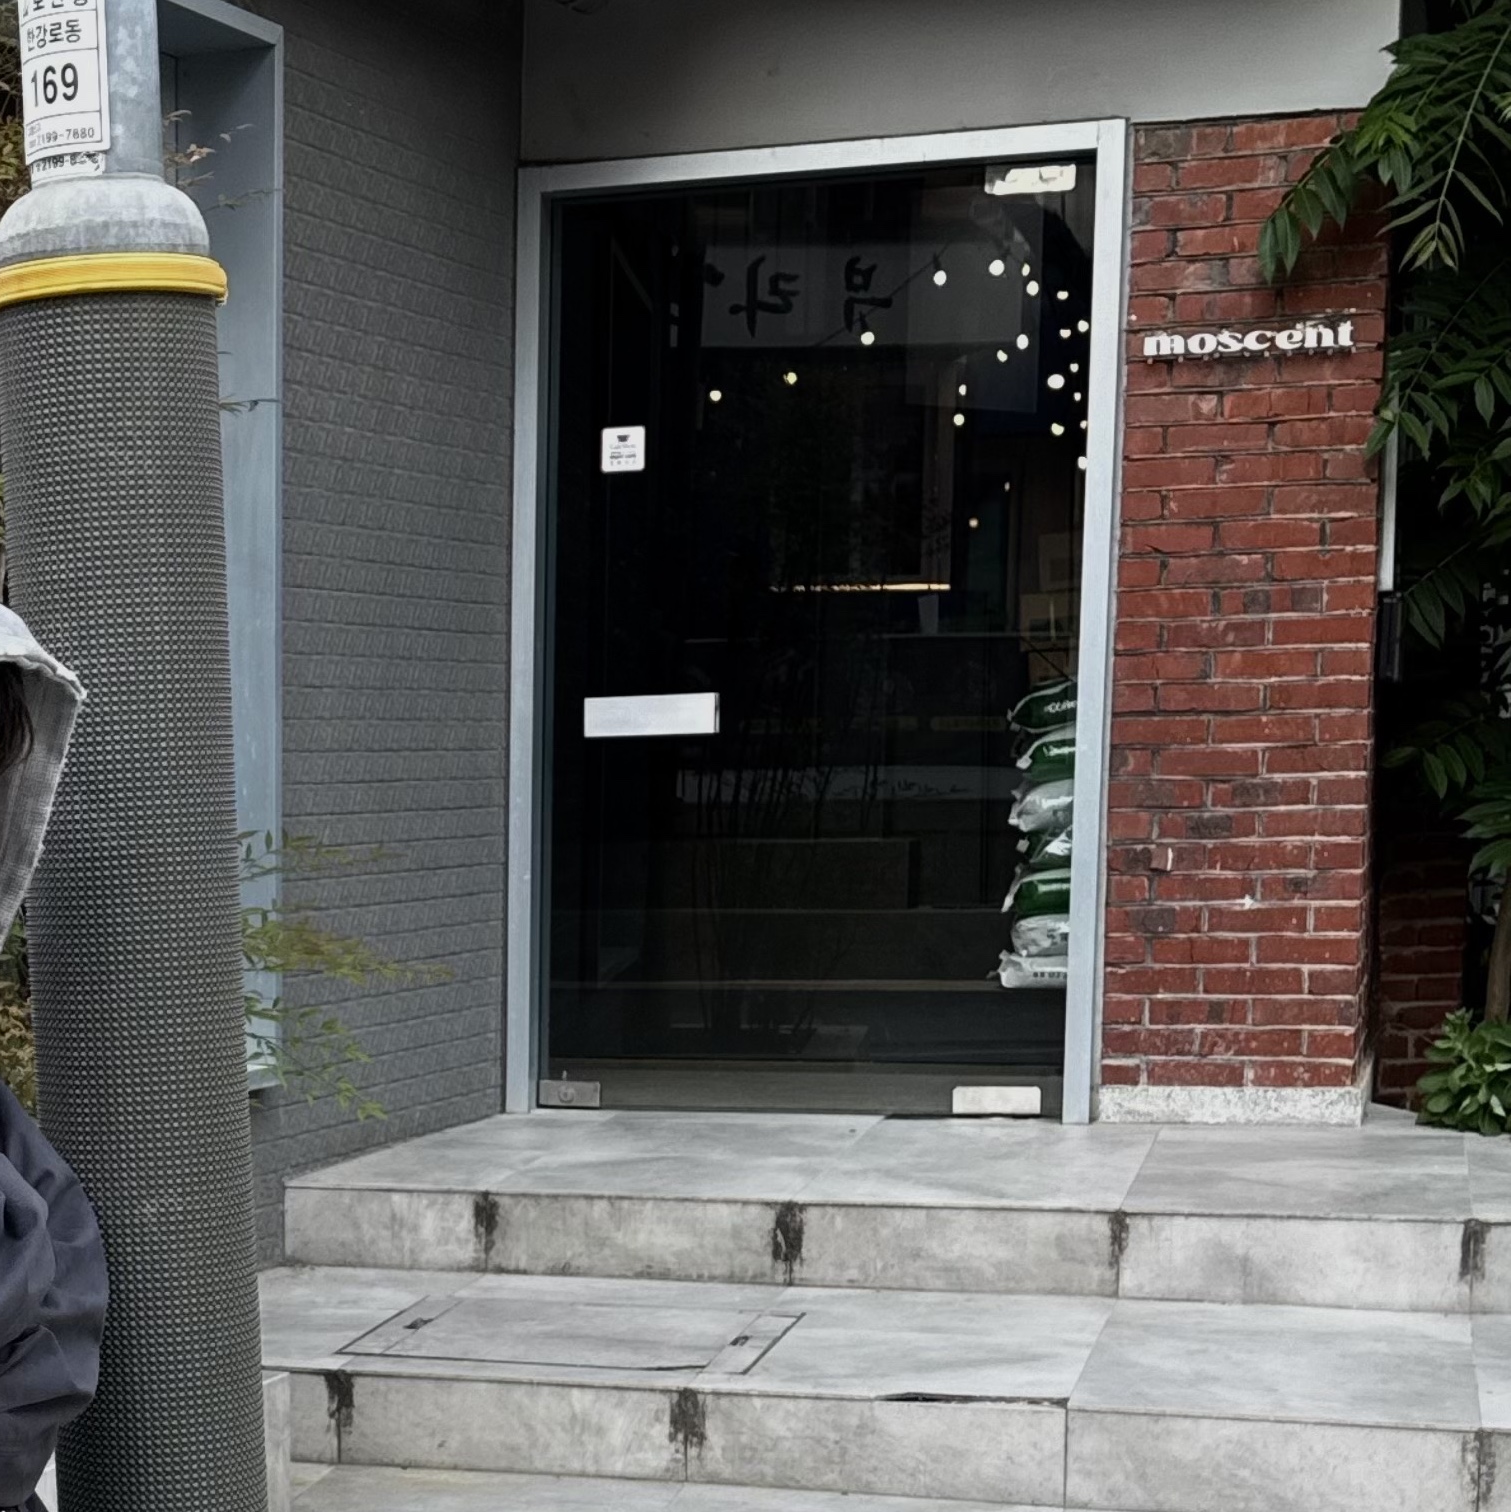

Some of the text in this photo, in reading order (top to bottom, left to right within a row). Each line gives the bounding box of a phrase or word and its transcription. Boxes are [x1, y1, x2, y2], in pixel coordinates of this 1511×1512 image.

[27, 19, 82, 52] 한강로동
[31, 62, 79, 108] 169
[1143, 320, 1354, 356] moscent
